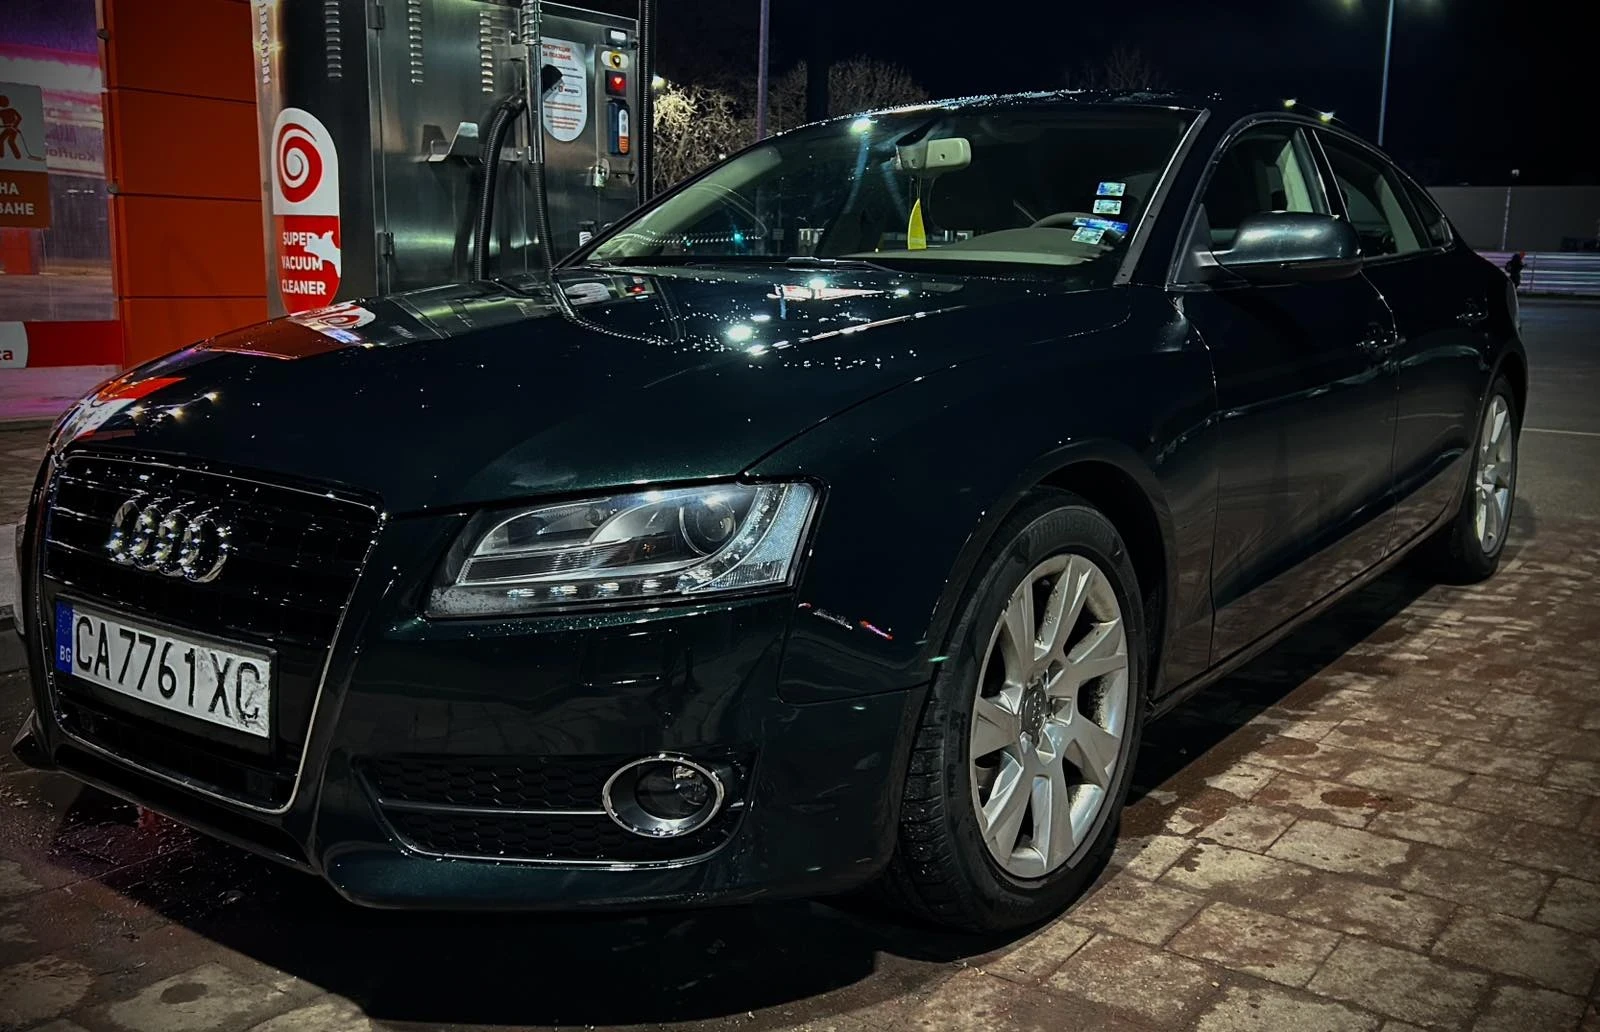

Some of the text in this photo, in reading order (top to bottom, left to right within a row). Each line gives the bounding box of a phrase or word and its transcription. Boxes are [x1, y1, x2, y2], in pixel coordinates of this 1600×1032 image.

[281, 256, 323, 271] VACUUM
[281, 279, 326, 296] CLEANER
[0, 350, 13, 361] a
[59, 644, 71, 663] BG
